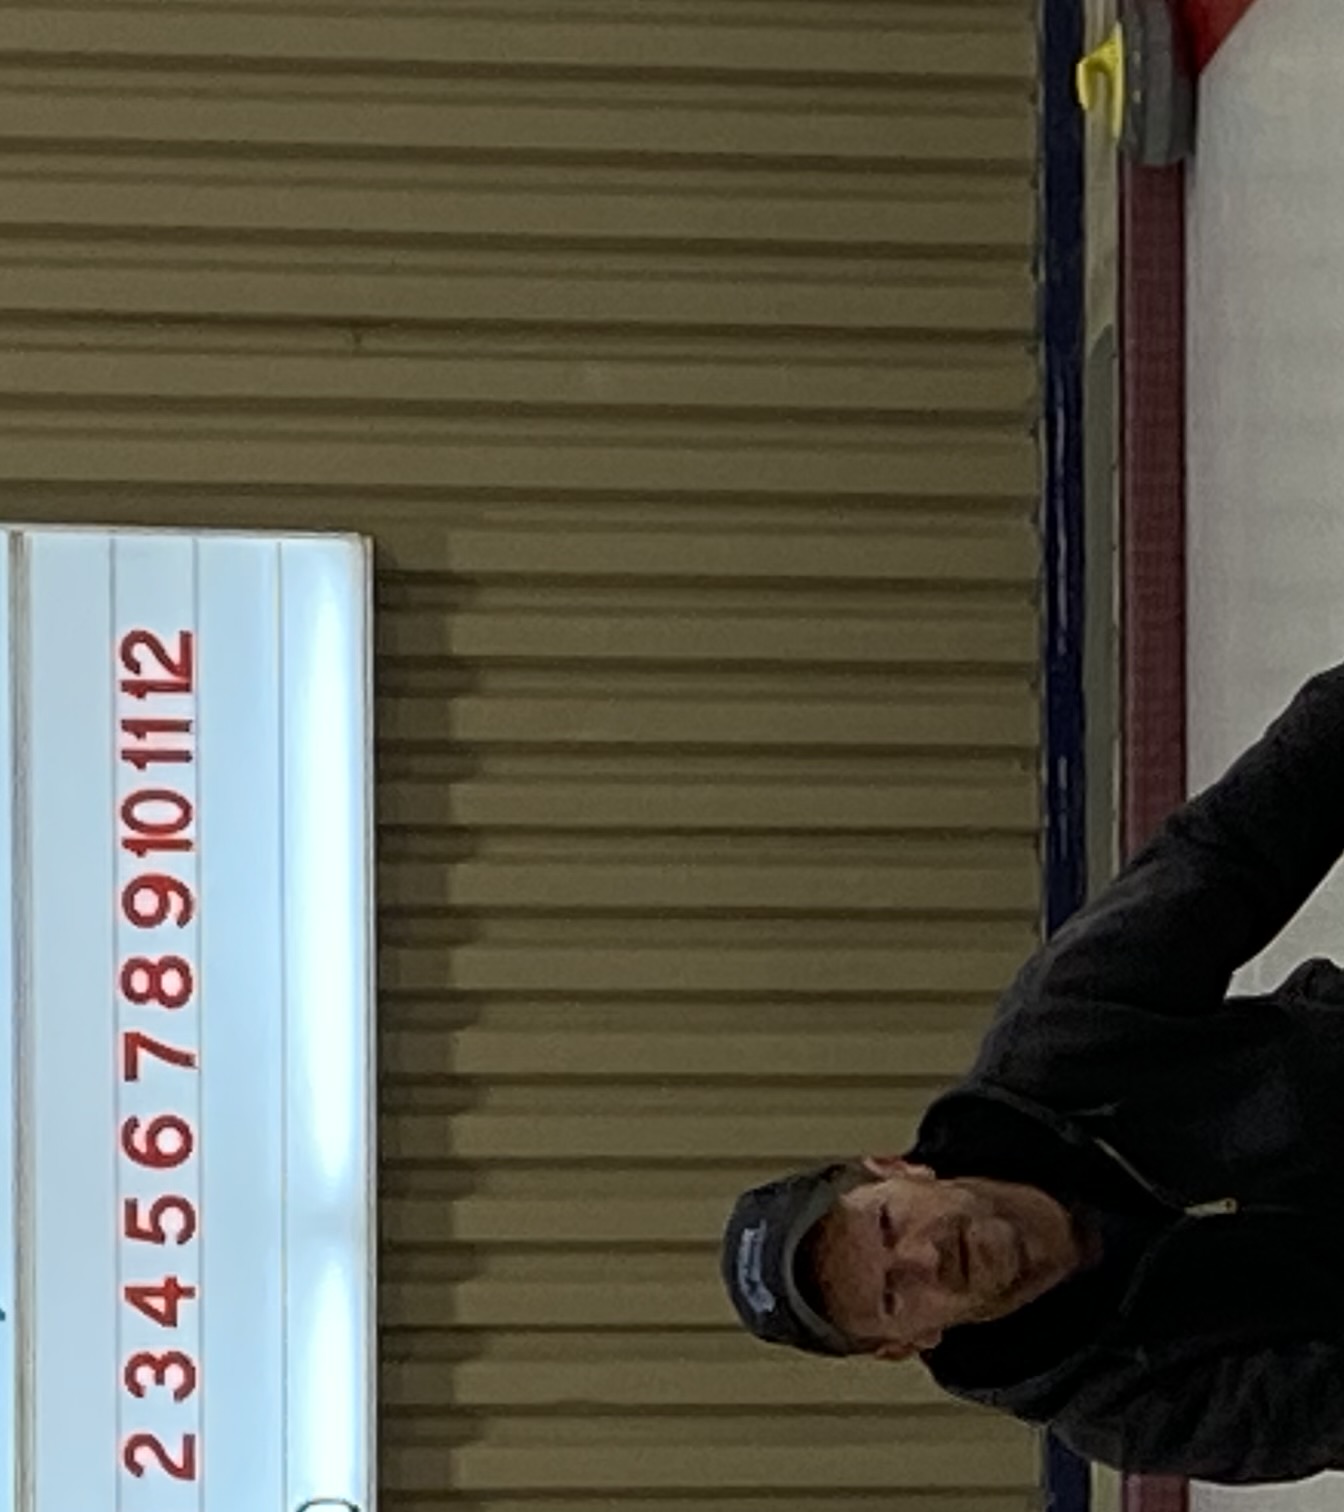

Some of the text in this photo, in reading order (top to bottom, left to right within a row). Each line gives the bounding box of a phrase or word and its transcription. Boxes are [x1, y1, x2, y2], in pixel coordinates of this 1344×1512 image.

[119, 629, 194, 700] 12
[120, 719, 194, 771] 11
[121, 788, 194, 858] 10
[121, 873, 194, 929] 9
[119, 955, 194, 1009] 8
[122, 1031, 198, 1082] 7
[121, 1114, 194, 1169] 6
[124, 1194, 196, 1246] 5
[124, 1276, 195, 1328] 4
[124, 1350, 197, 1402] 3
[123, 1433, 196, 1480] 2
